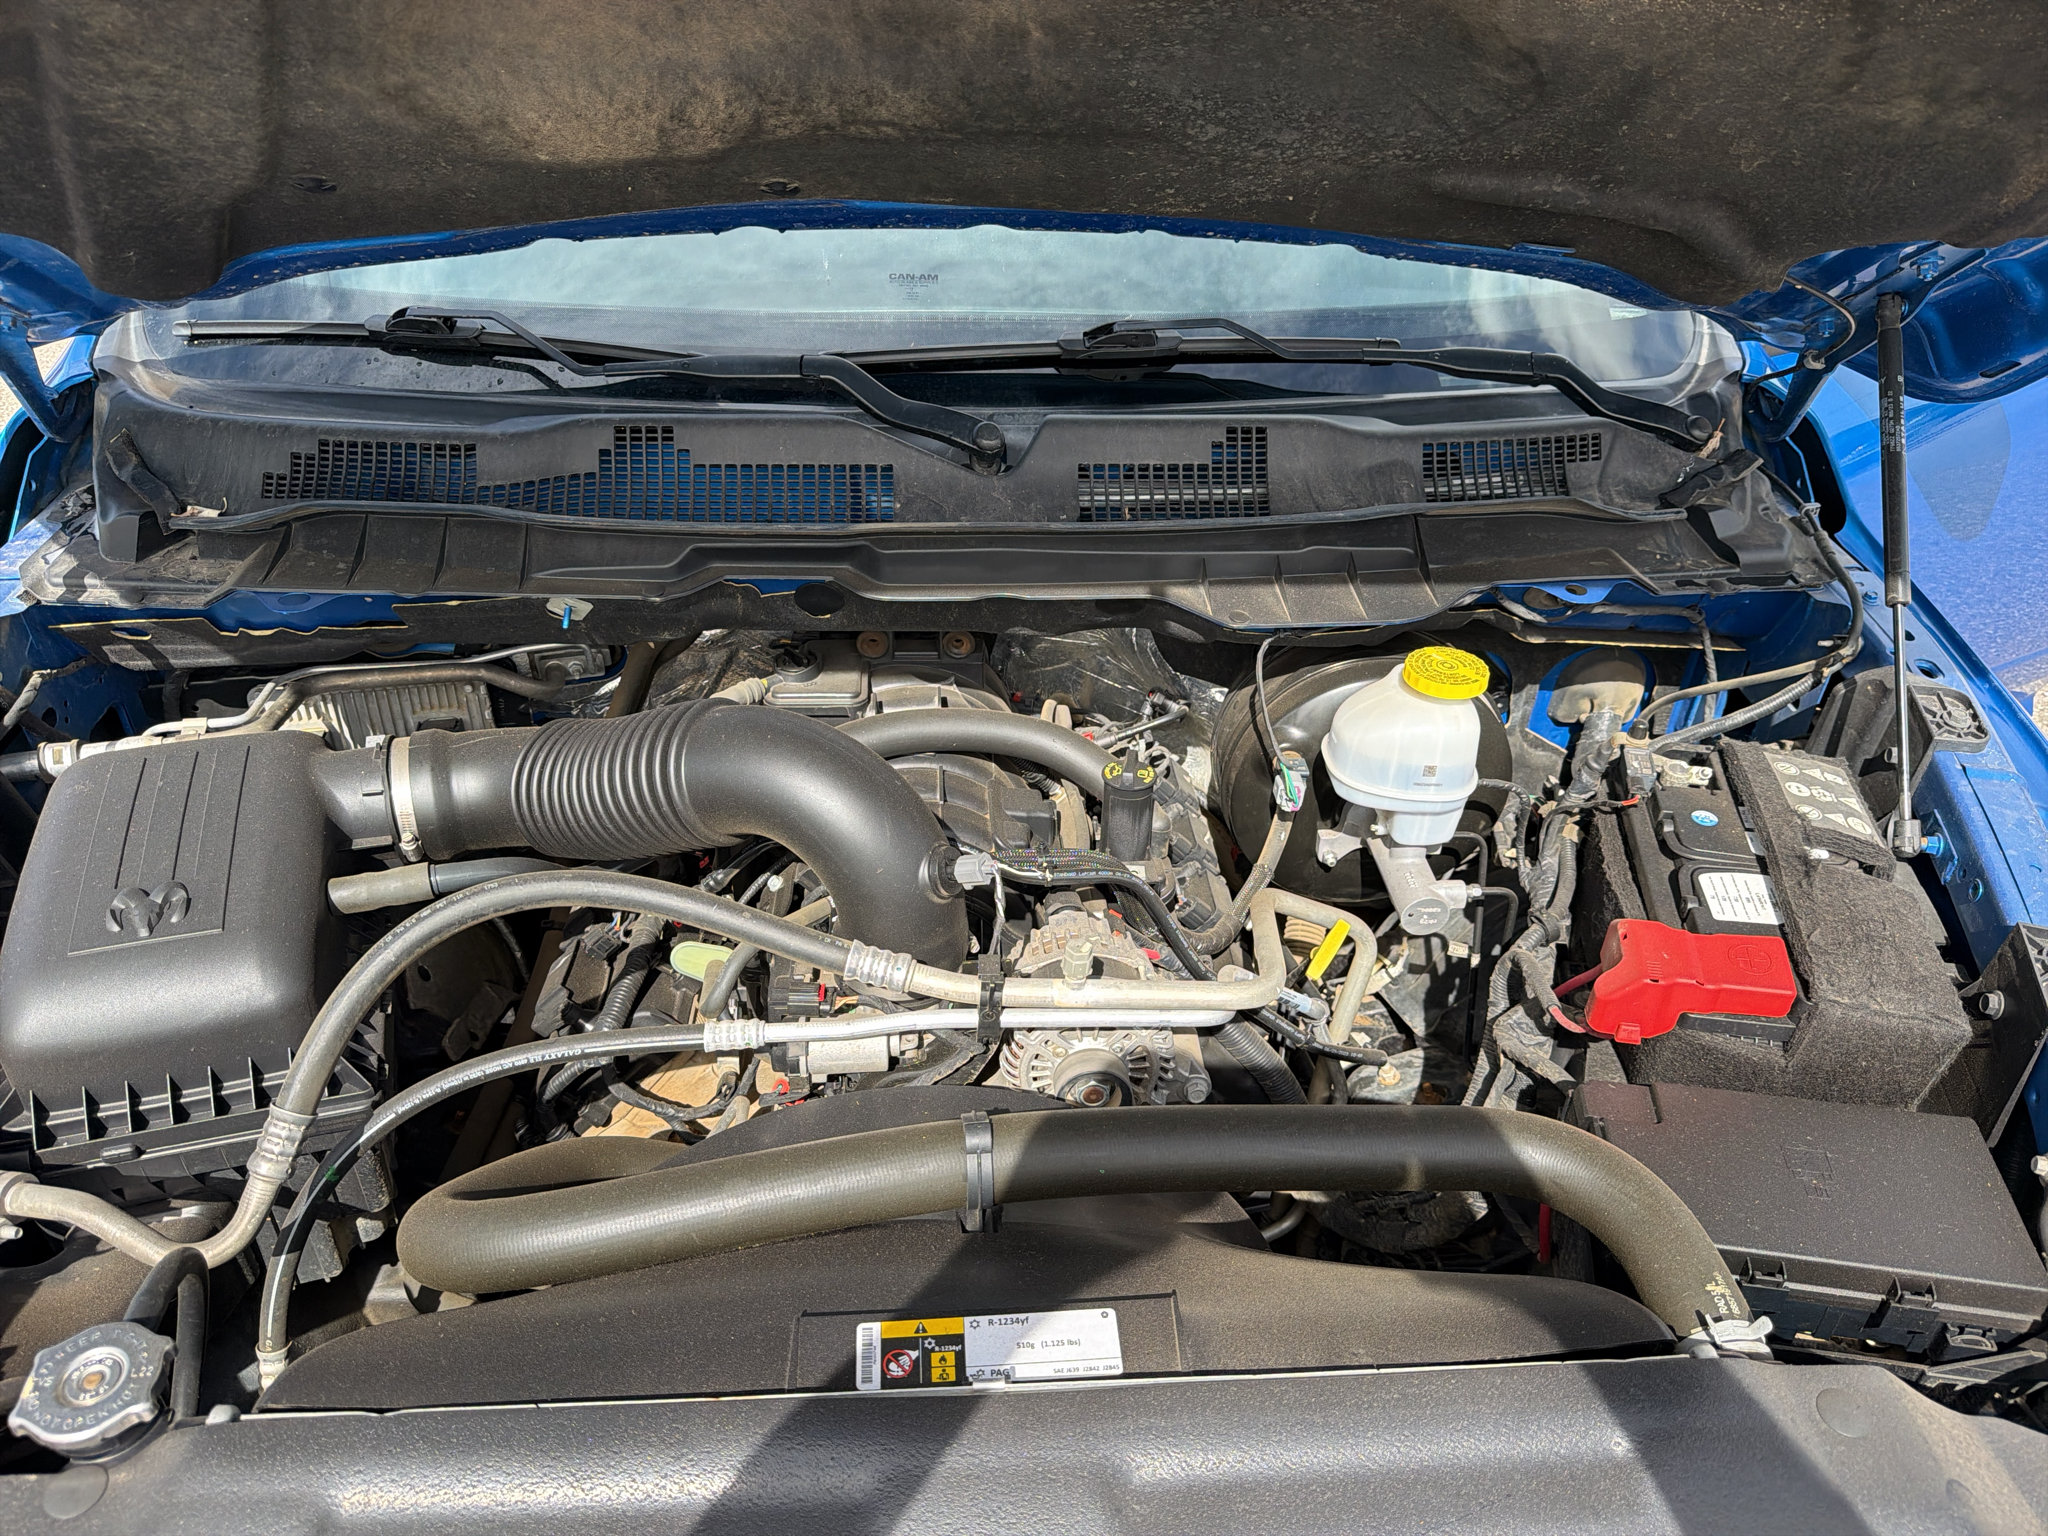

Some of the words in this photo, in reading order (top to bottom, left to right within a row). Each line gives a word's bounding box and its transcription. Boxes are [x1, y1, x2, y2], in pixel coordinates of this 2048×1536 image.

[889, 273, 939, 281] CAN-AM
[543, 1049, 582, 1061] GALAXY
[486, 1065, 502, 1075] HOSE
[1714, 1296, 1729, 1313] RAD
[987, 1315, 1029, 1327] R-1234yf
[1016, 1340, 1035, 1350] 510g
[1041, 1339, 1064, 1348] (1.125
[1066, 1337, 1081, 1347] lbs)
[990, 1368, 1010, 1378] PAG
[63, 1409, 110, 1430] OPEN
